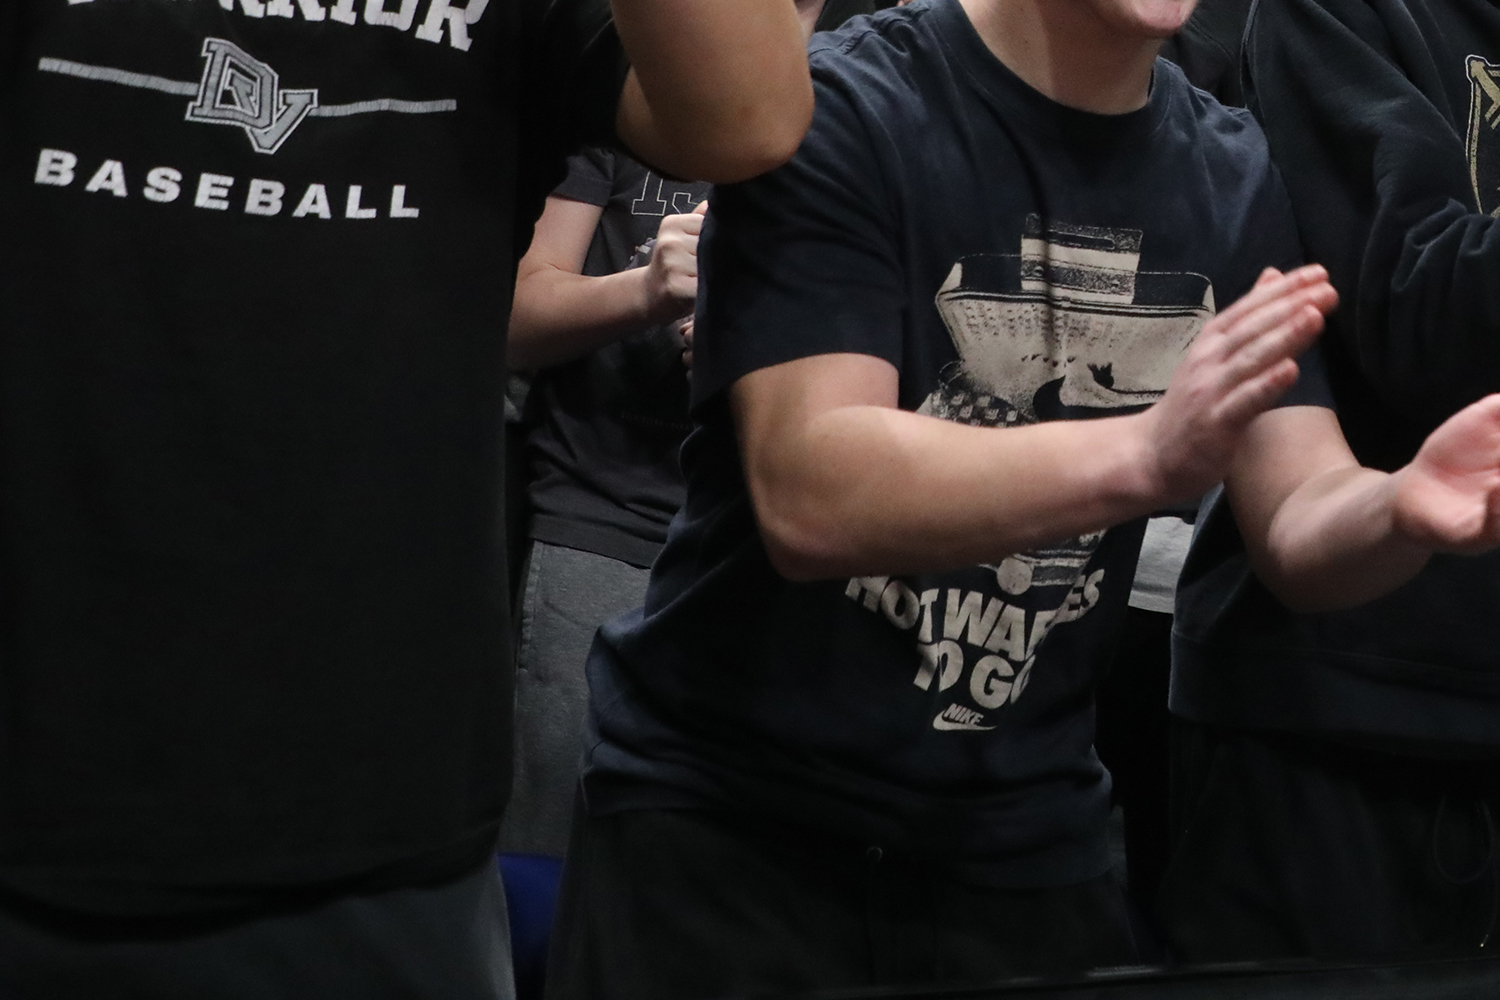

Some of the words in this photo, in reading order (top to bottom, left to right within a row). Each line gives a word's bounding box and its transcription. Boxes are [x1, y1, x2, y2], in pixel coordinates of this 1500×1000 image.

[33, 149, 420, 220] BASEBALL
[845, 575, 940, 643] HOT
[942, 702, 985, 726] NIKE
